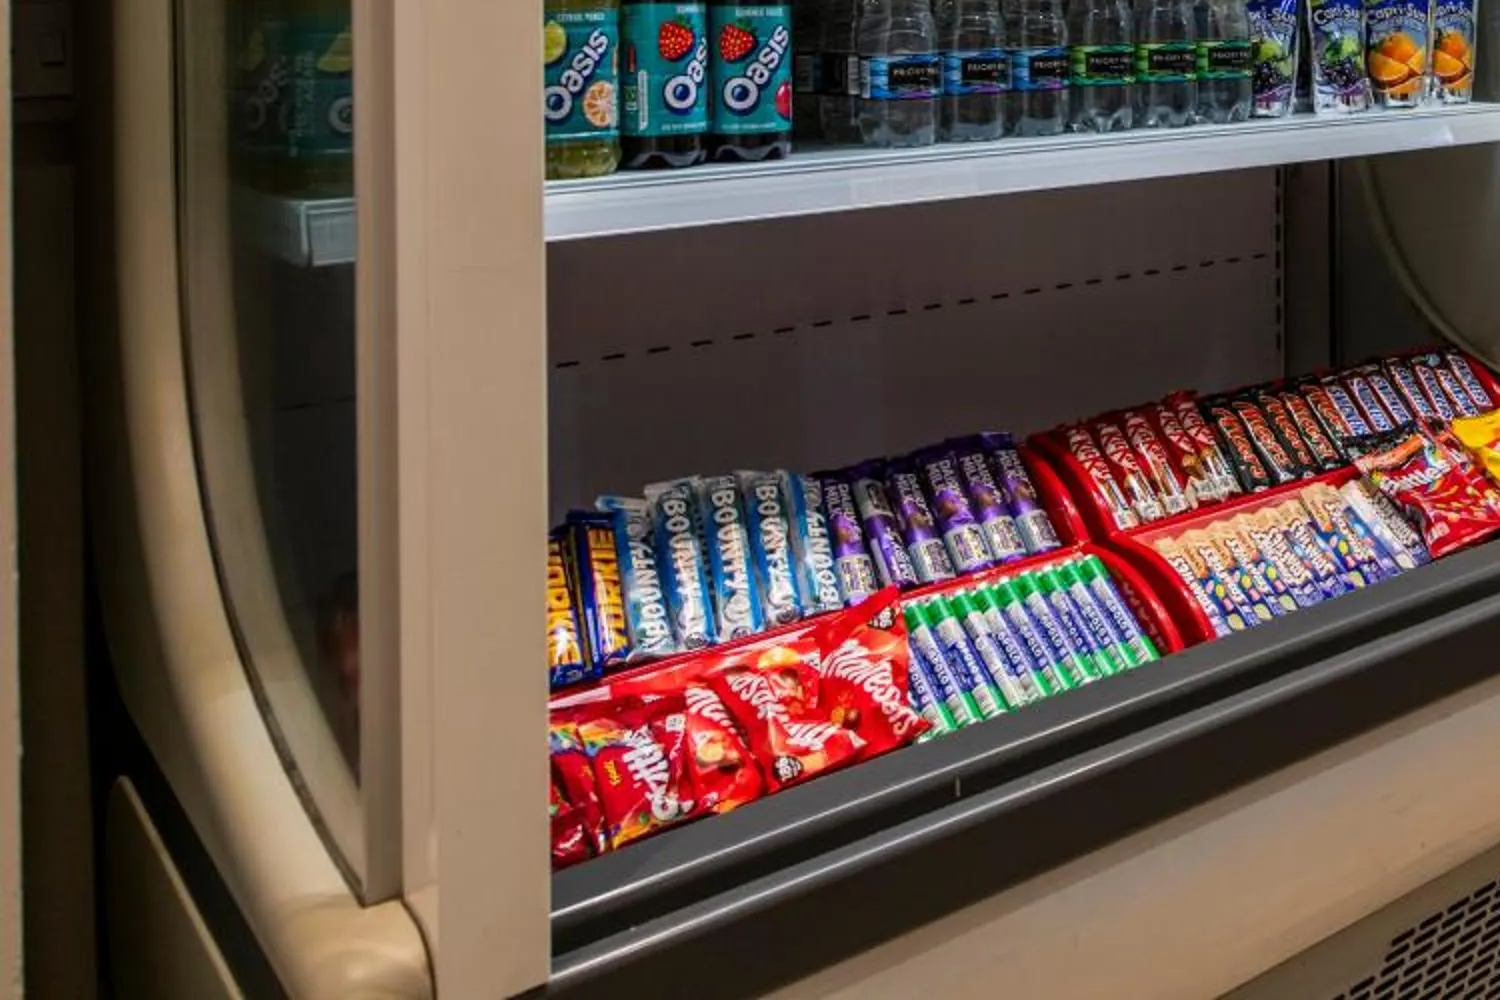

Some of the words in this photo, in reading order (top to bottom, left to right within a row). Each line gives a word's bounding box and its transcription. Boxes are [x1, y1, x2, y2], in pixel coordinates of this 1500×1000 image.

[1314, 4, 1360, 25] Capri-Su
[544, 29, 608, 120] Oasis
[665, 37, 707, 109] Oas
[724, 25, 789, 110] Oasis
[711, 489, 749, 588] BOUNTY
[806, 509, 845, 606] BOUNTY
[588, 528, 628, 651] YORKIE
[629, 541, 669, 639] BOUNTY
[821, 635, 920, 735] Maltesers
